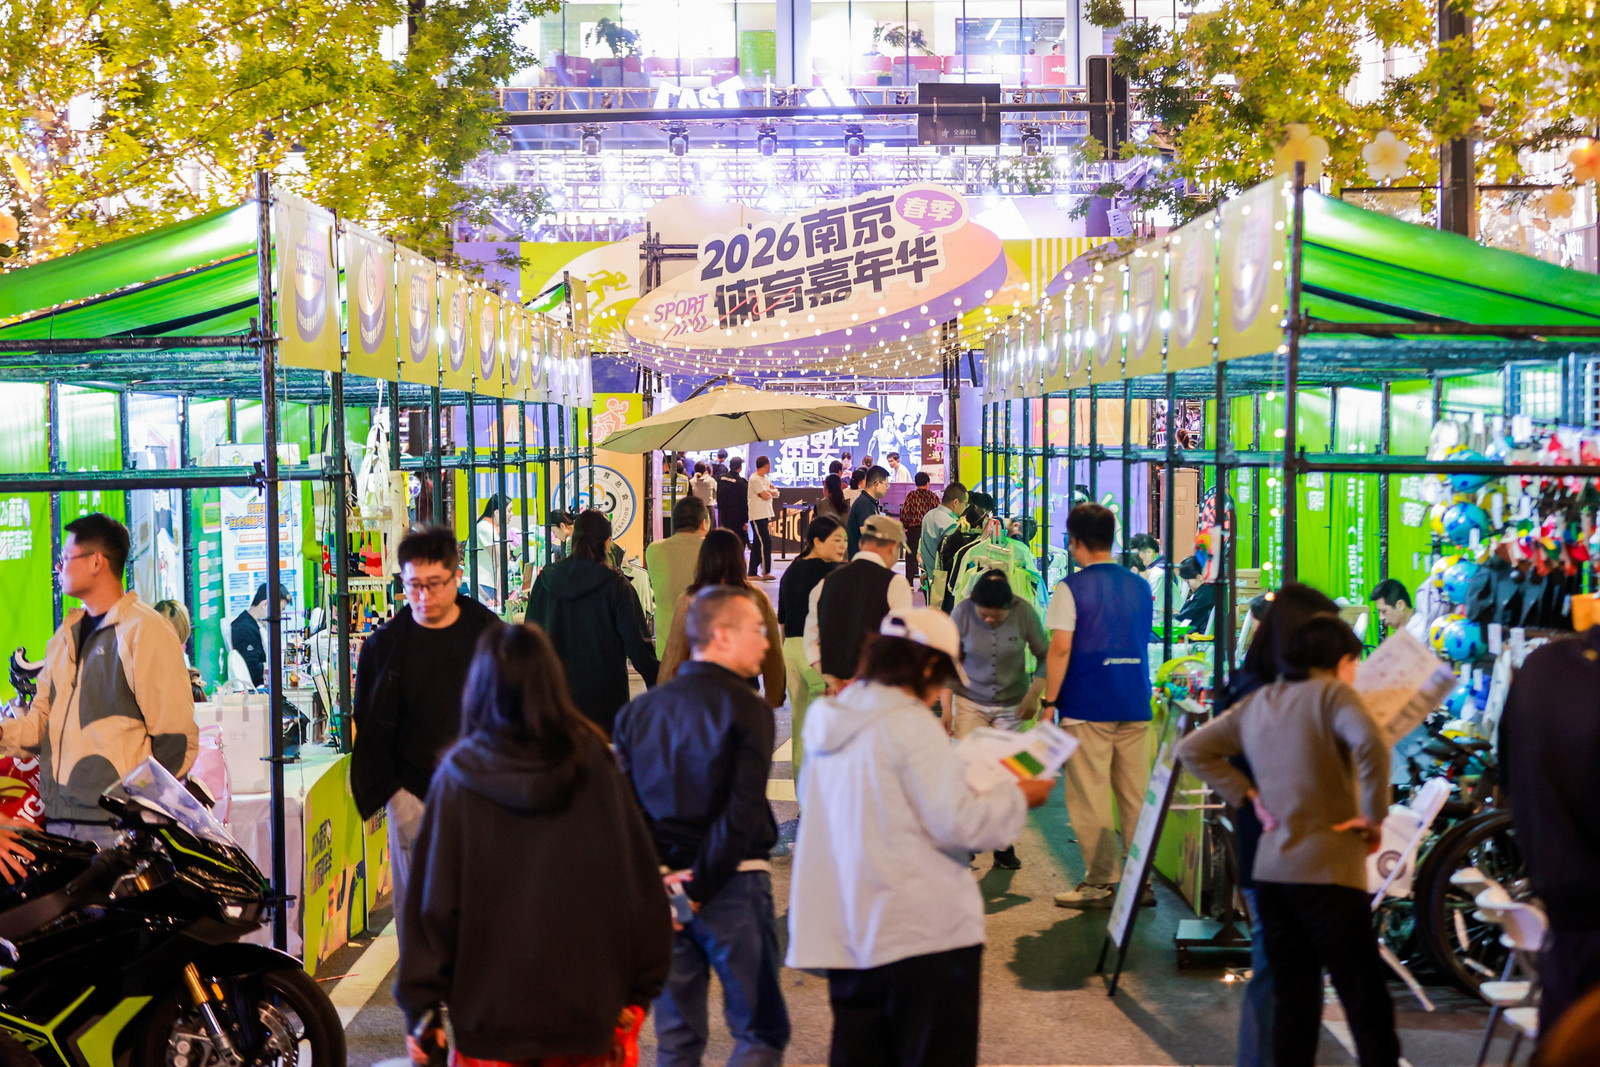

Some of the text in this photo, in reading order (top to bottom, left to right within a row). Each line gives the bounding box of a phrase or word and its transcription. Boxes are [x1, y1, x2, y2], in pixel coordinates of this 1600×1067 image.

[700, 195, 895, 281] 2026南京
[903, 197, 957, 222] 春季
[653, 293, 709, 323] SPORT
[713, 235, 939, 330] 体育嘉年华
